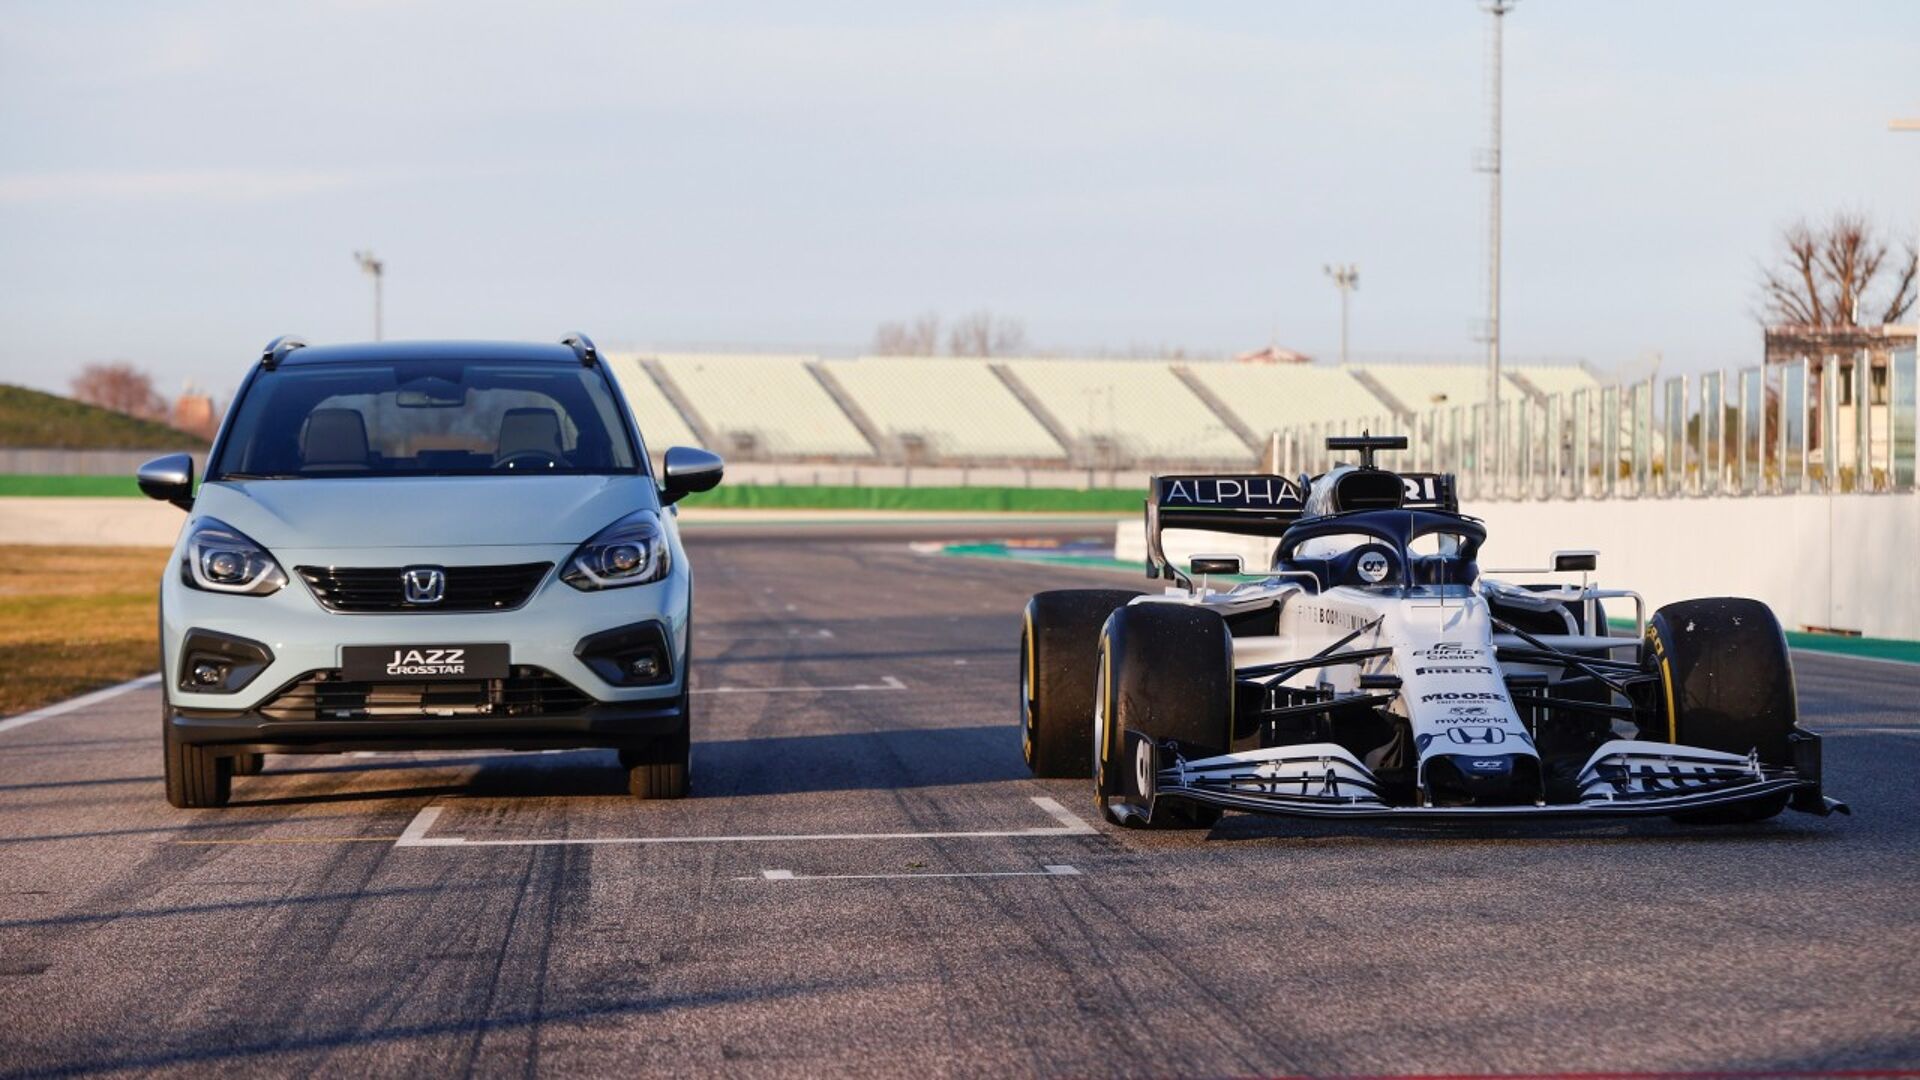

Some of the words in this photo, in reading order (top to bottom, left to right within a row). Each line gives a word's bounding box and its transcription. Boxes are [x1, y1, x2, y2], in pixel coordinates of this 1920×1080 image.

[1166, 479, 1301, 504] ALPHA
[386, 649, 465, 667] JAZZ
[386, 665, 465, 675] CROSSTAR
[1421, 692, 1507, 703] MOOSE
[1435, 717, 1508, 725] myWorld
